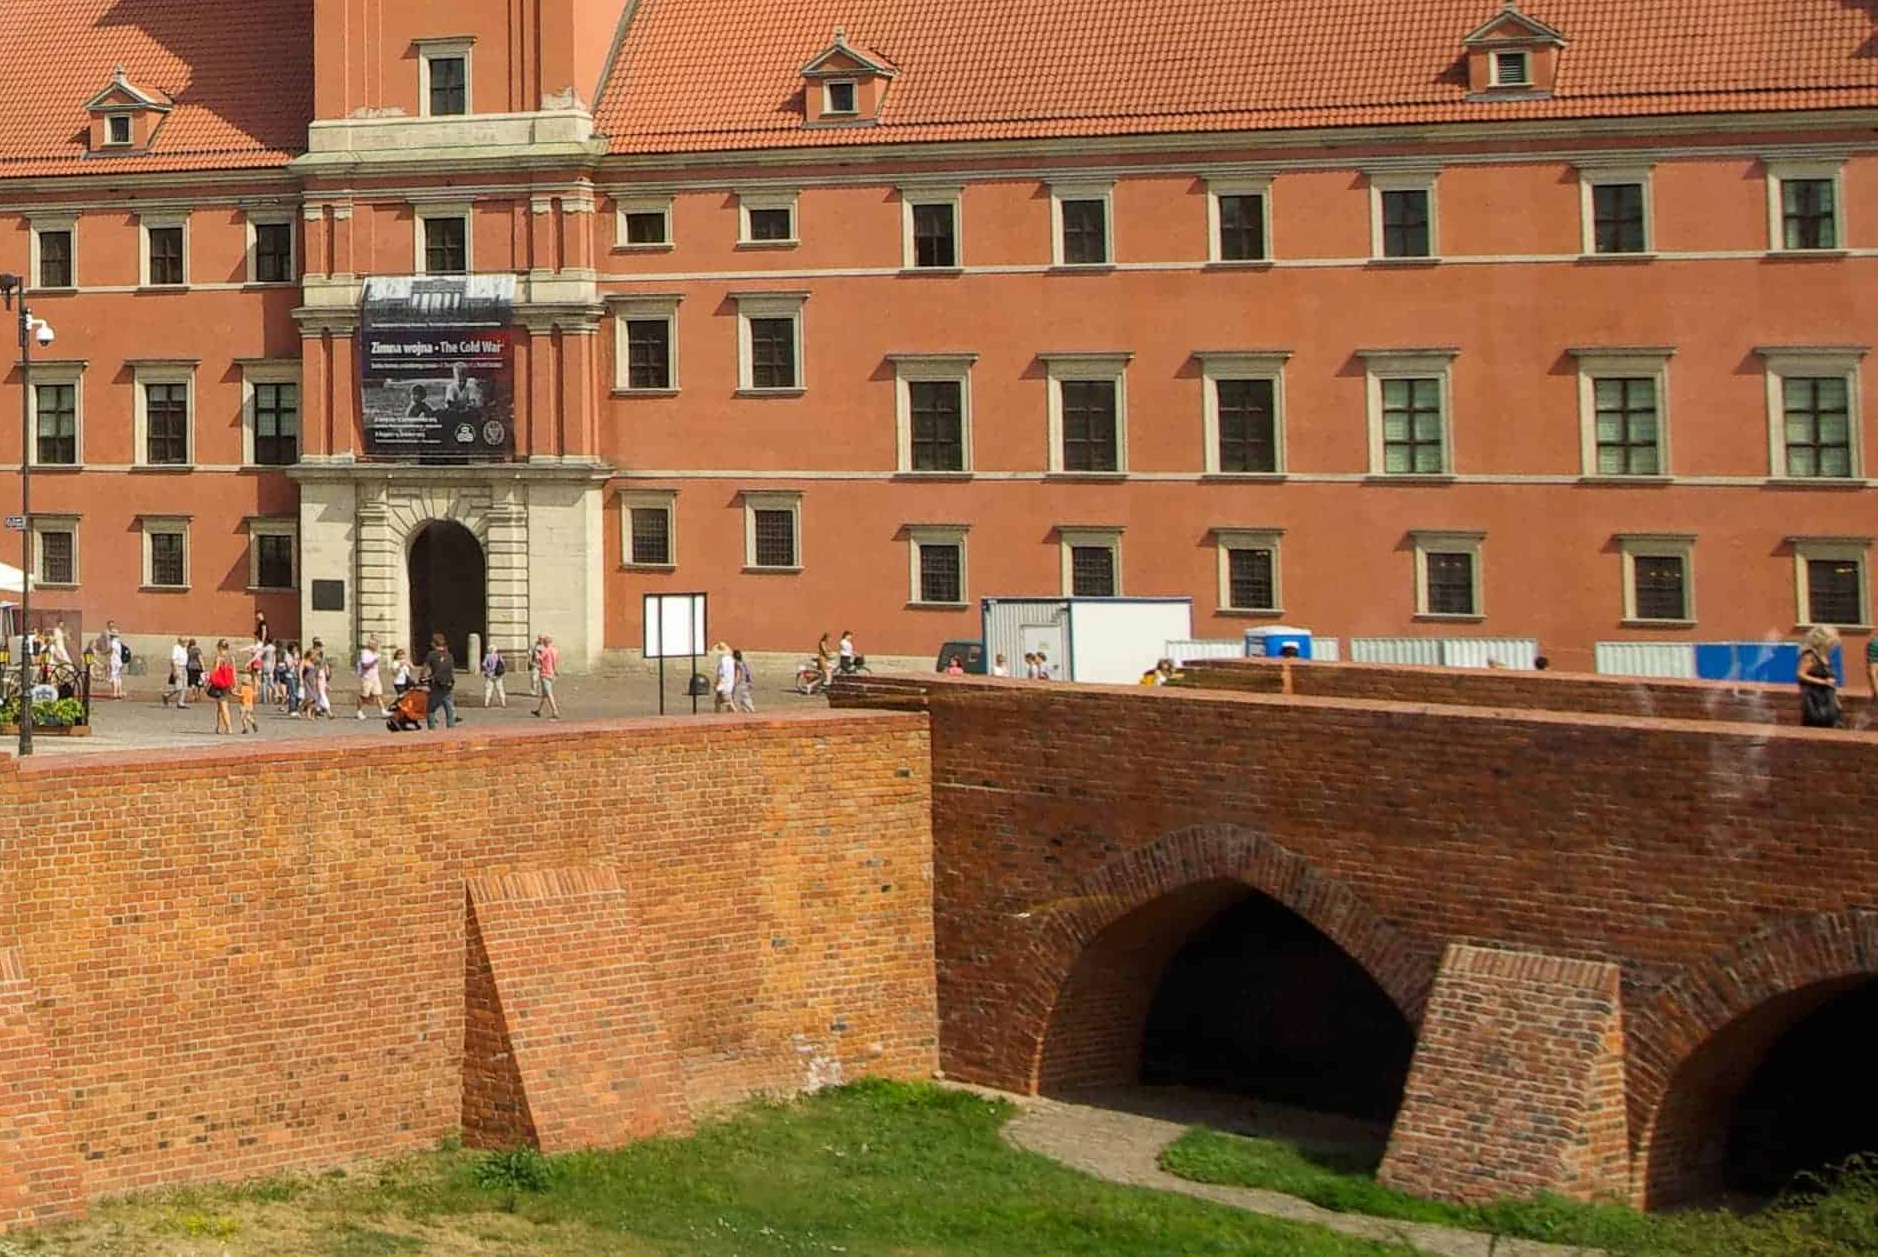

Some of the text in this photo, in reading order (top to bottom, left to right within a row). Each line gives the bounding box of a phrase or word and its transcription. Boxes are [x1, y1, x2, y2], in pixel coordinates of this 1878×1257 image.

[371, 341, 503, 356] Zimna wojna The Cold War
